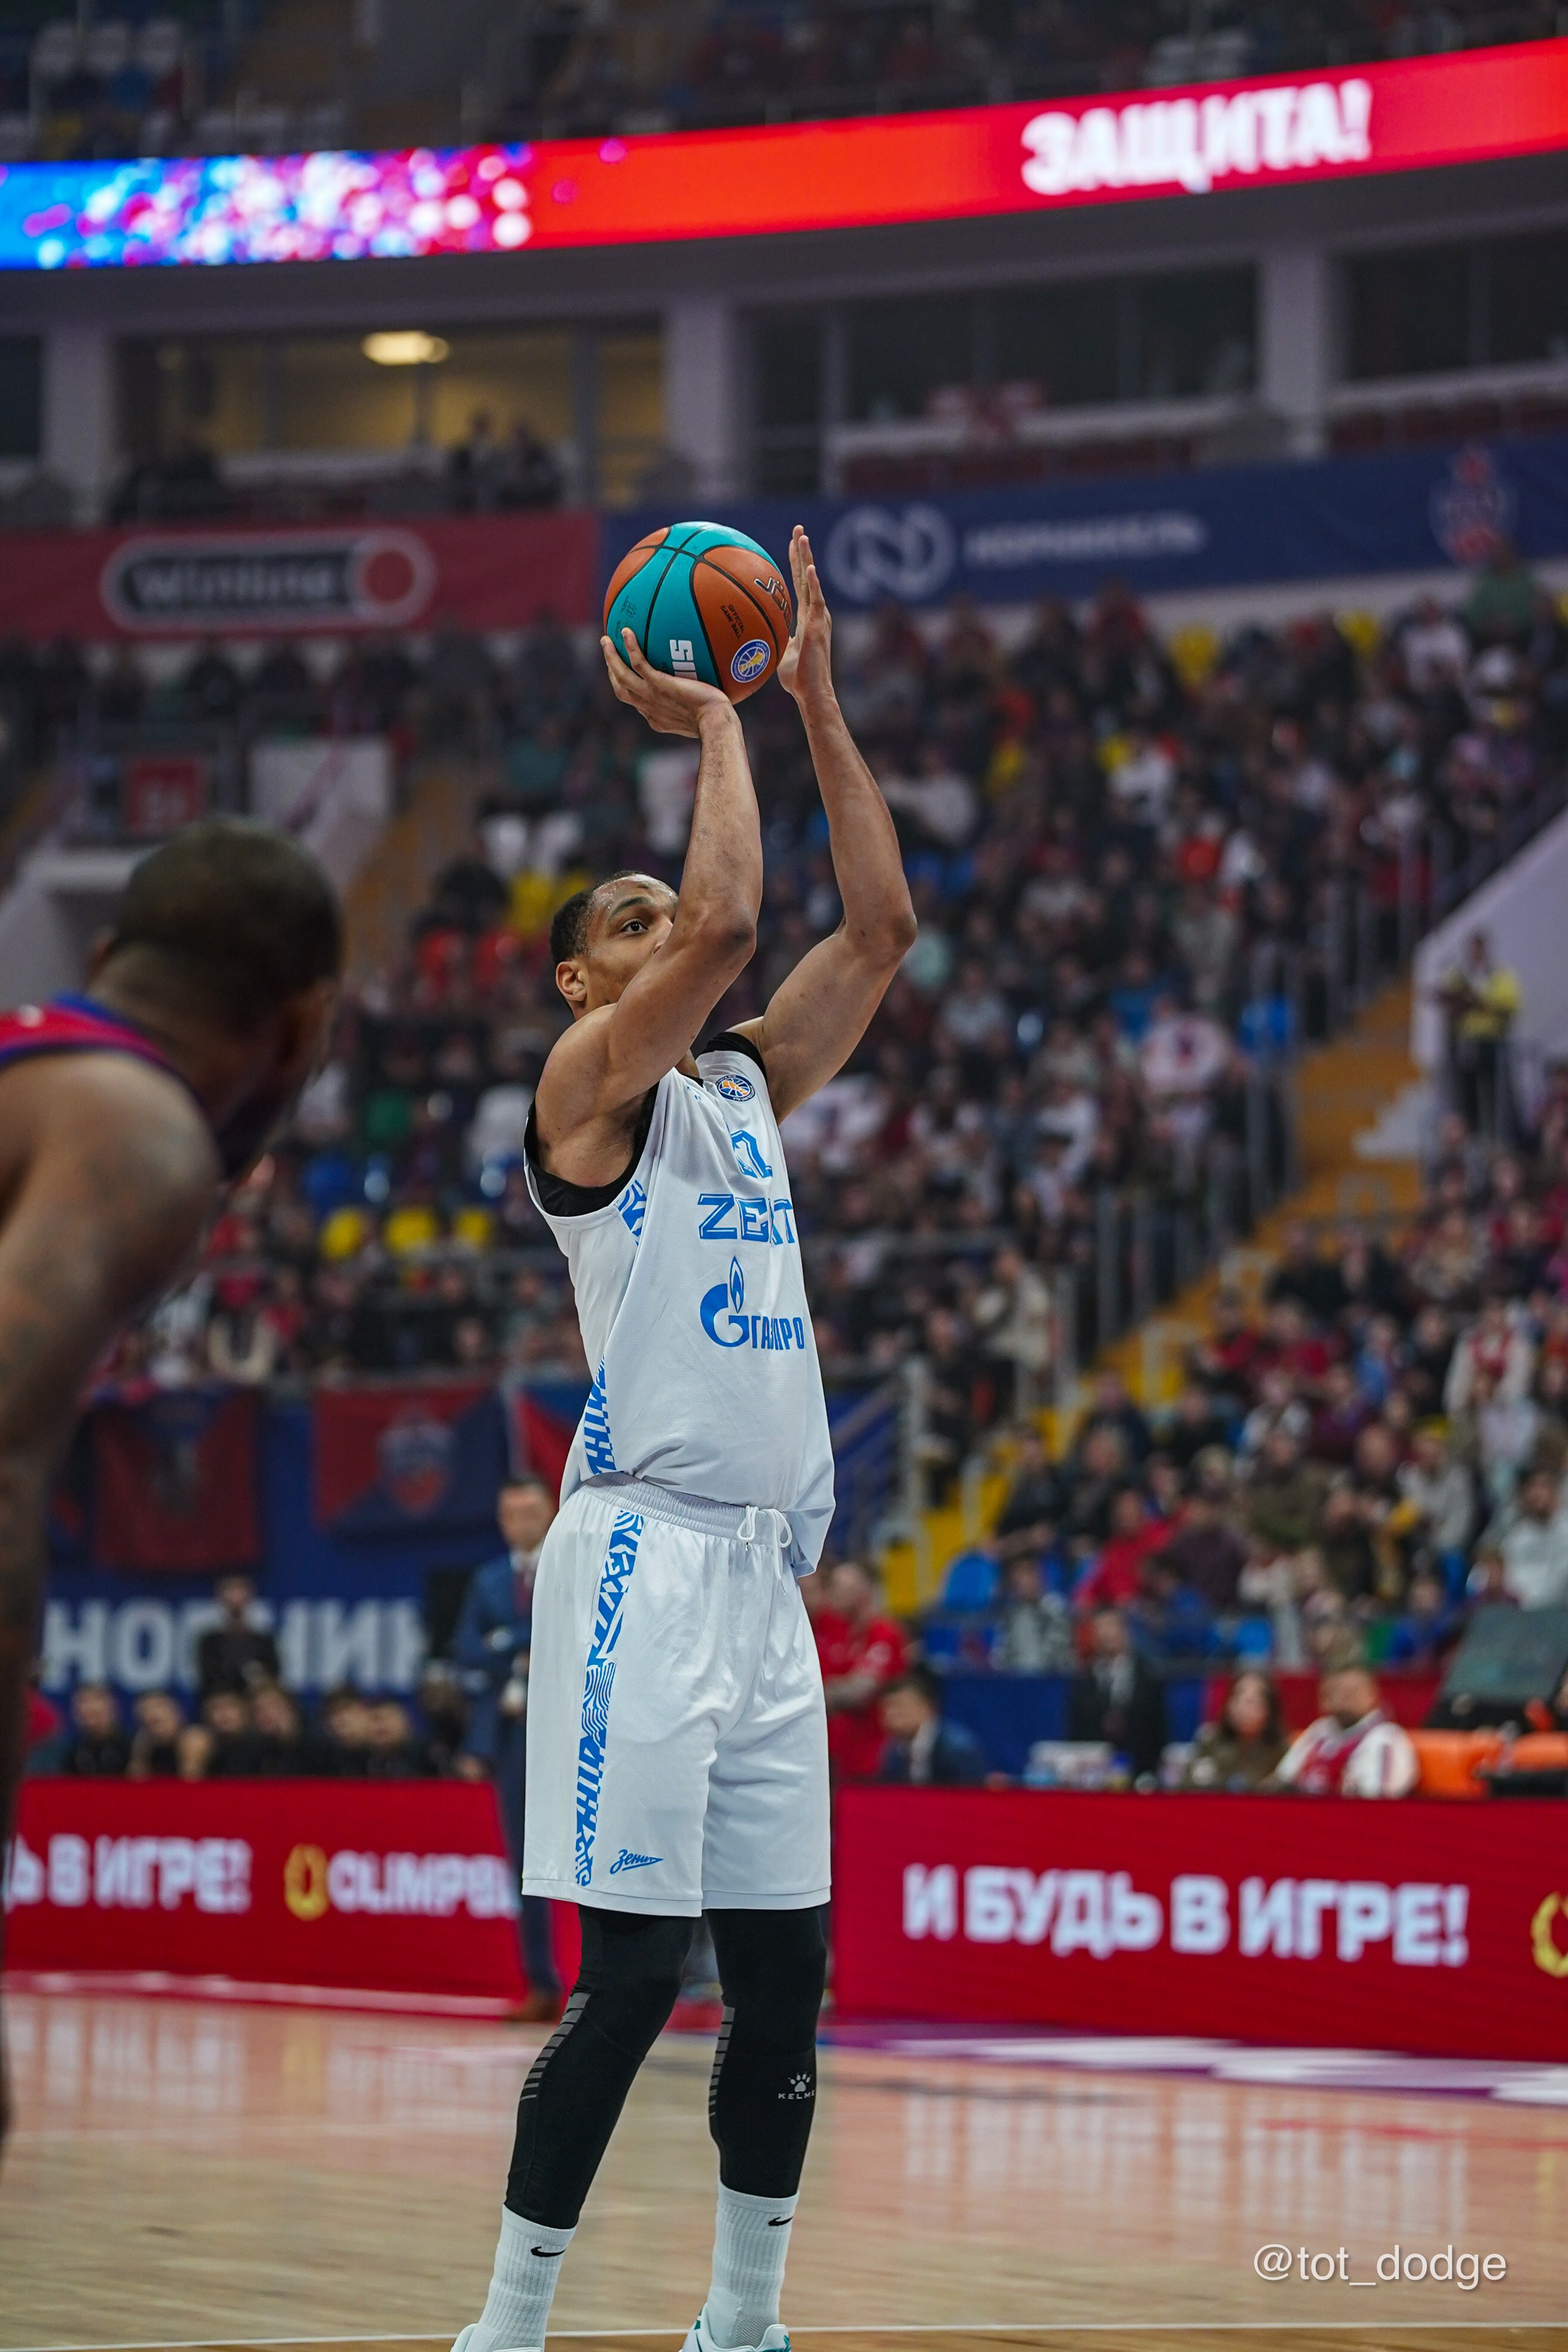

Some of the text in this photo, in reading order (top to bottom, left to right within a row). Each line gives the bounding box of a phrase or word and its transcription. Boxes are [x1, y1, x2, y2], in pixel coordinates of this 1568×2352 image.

[1021, 78, 1372, 194] ЗАЩИТА!
[48, 1833, 89, 1907] В
[92, 1834, 252, 1913] ИГРЕ!
[902, 1862, 1471, 1967] И БУДЬ В ИГРЕ!
